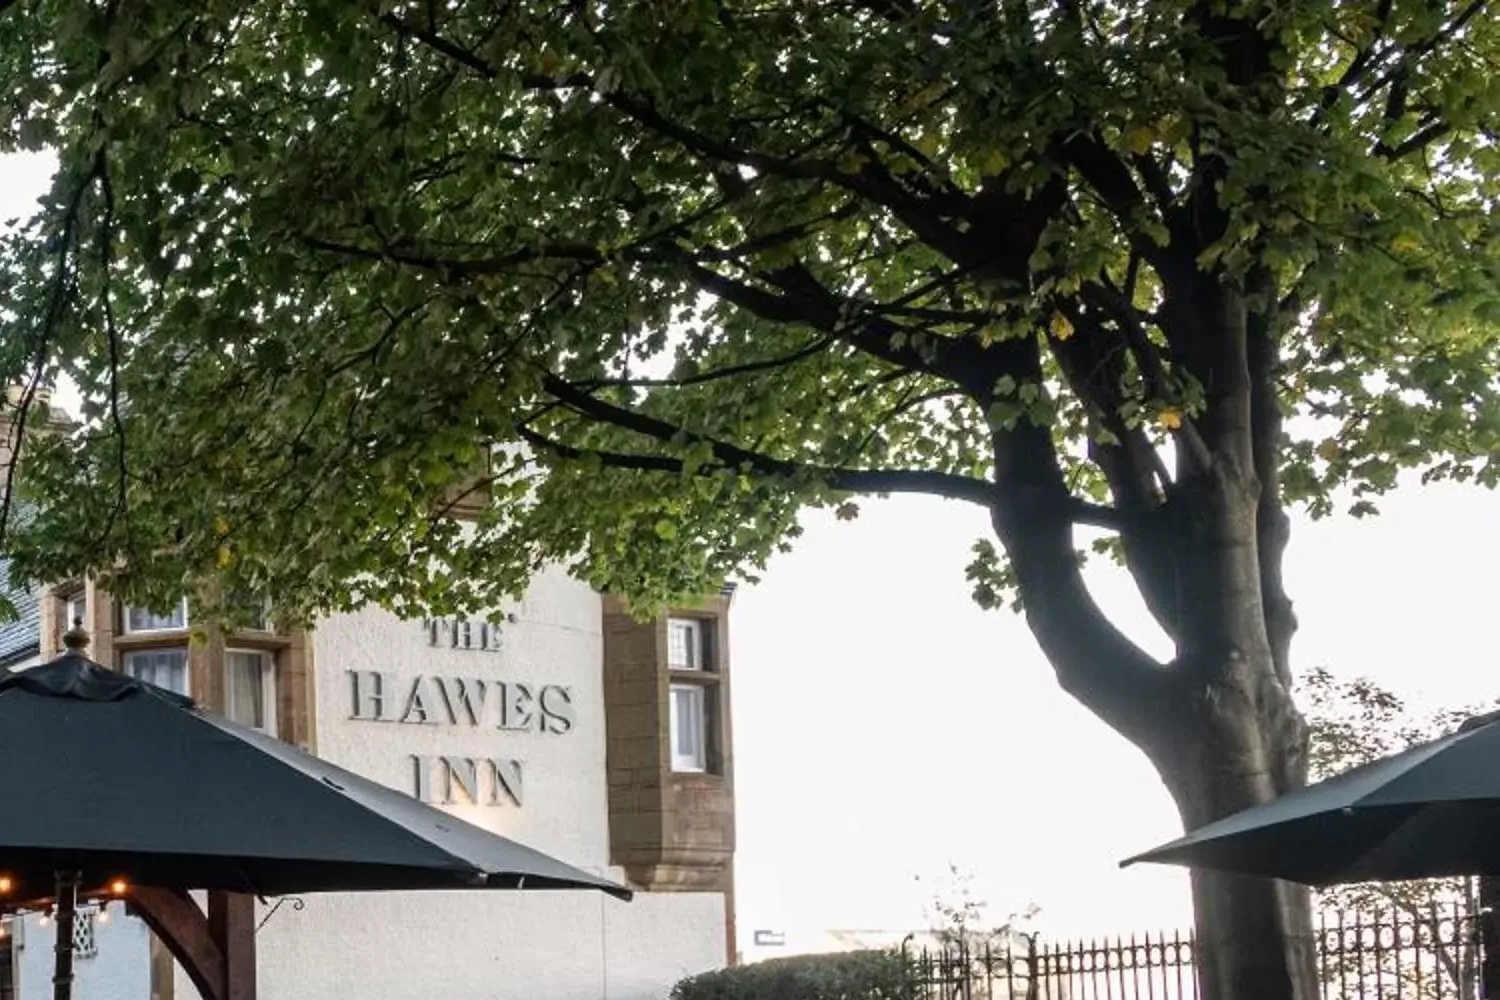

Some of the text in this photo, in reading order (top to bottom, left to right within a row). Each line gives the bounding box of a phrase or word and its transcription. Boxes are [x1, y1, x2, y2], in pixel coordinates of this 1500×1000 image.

[422, 615, 504, 652] THE
[345, 668, 575, 735] HAWES
[410, 754, 523, 808] INN
